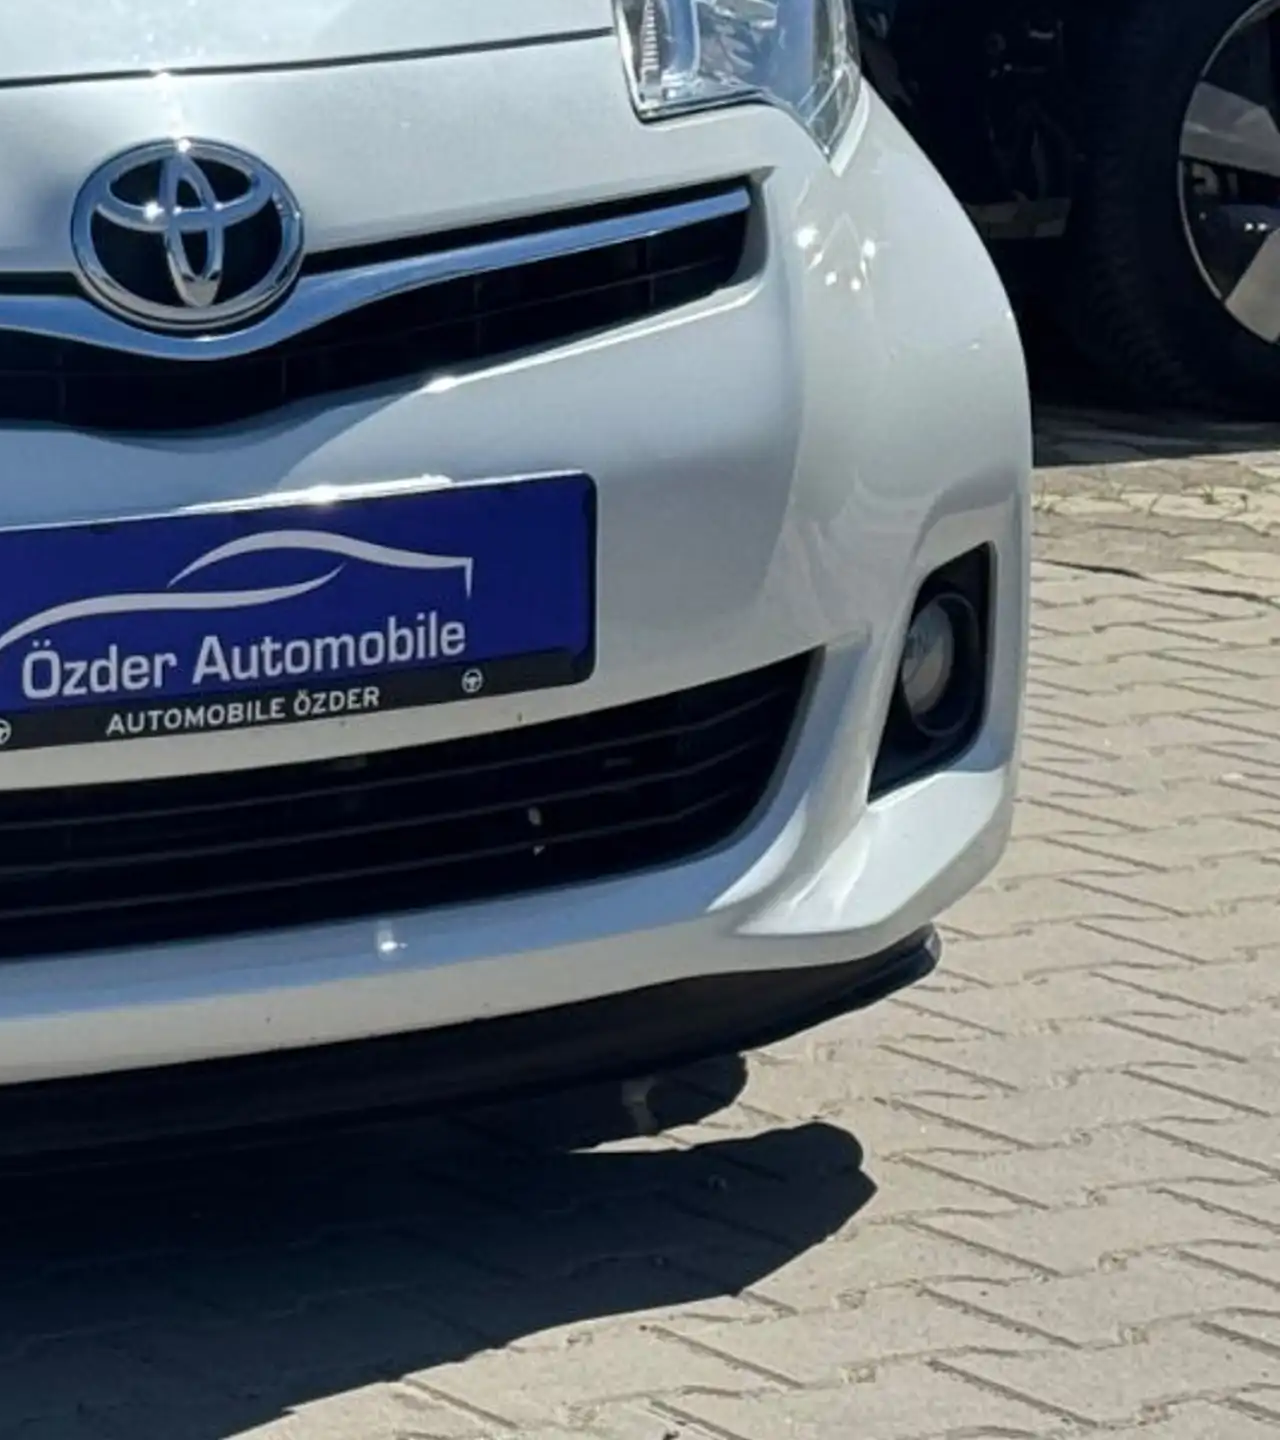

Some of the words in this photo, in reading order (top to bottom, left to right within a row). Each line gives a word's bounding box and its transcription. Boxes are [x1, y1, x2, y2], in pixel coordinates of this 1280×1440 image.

[20, 638, 178, 700] Özder
[191, 610, 467, 686] Automobile
[105, 698, 286, 737] AUTOMOBILE
[292, 687, 381, 718] ÖZDER
